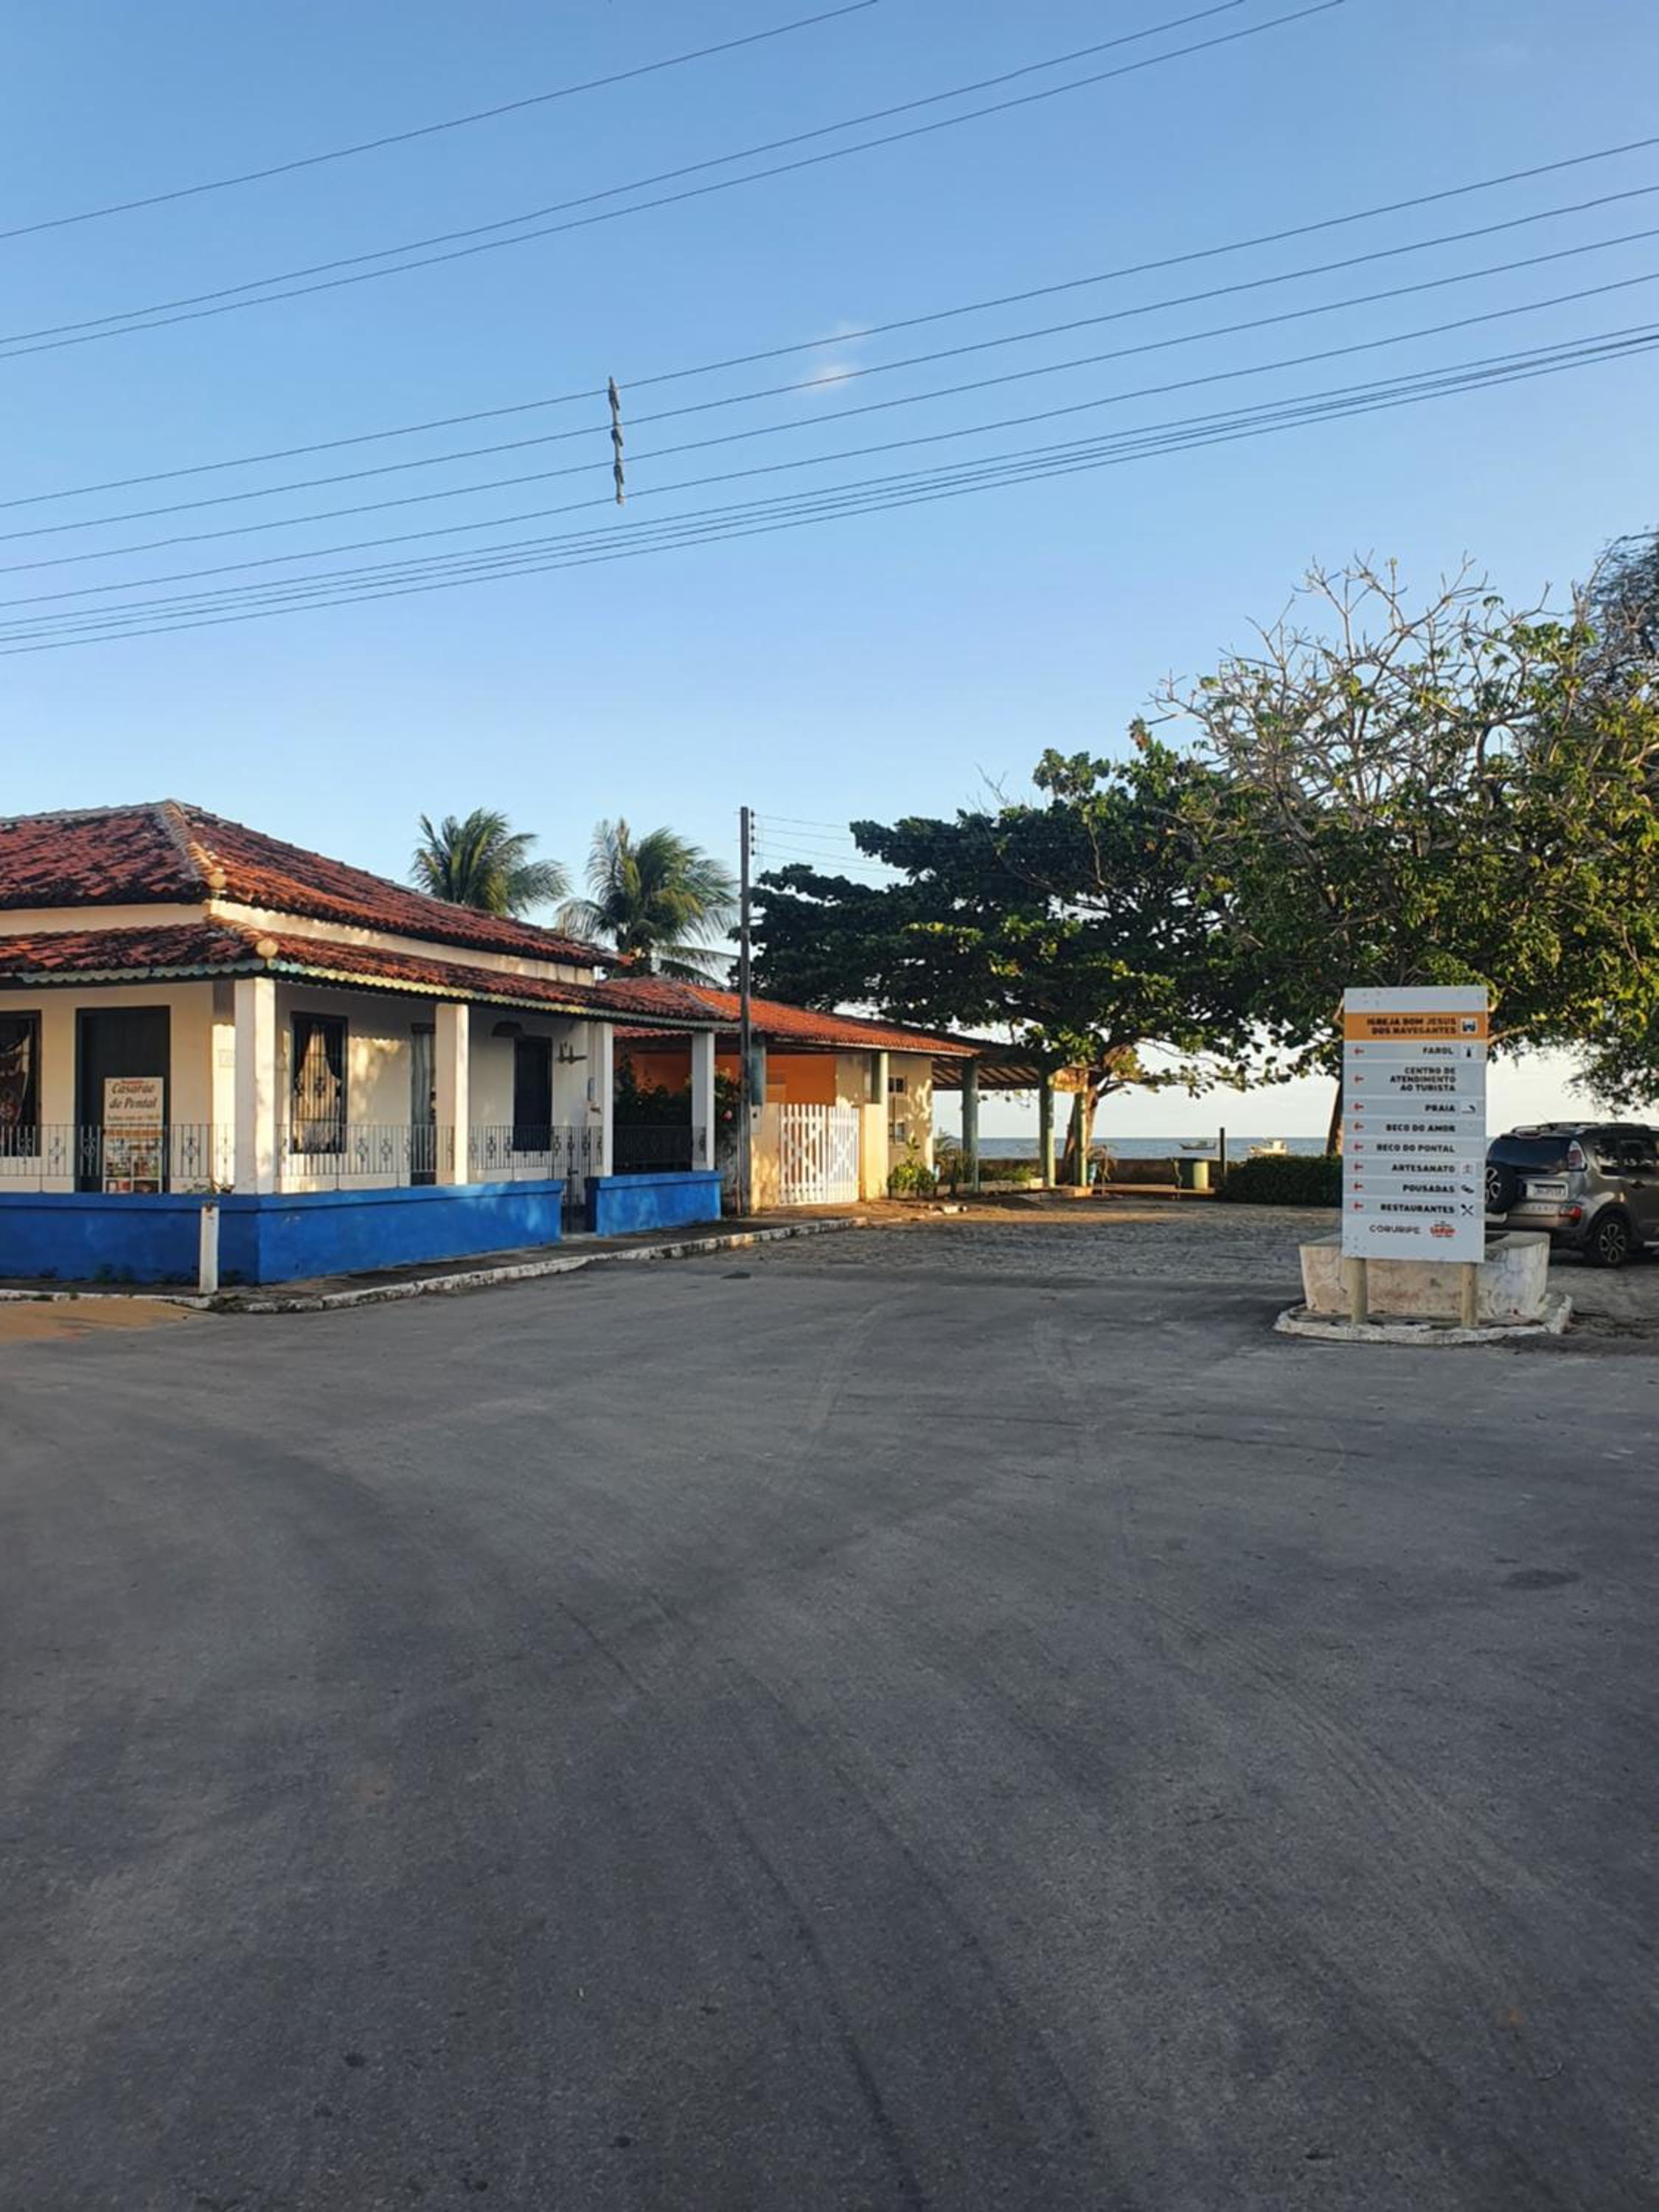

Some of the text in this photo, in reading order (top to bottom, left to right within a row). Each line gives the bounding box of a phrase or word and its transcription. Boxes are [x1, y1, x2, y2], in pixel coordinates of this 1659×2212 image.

[125, 1097, 158, 1108] Pontal
[1418, 1144, 1455, 1152] PONTAL
[1392, 1164, 1455, 1172] ARTESANATO
[1381, 1204, 1455, 1214] RESTAURANTES
